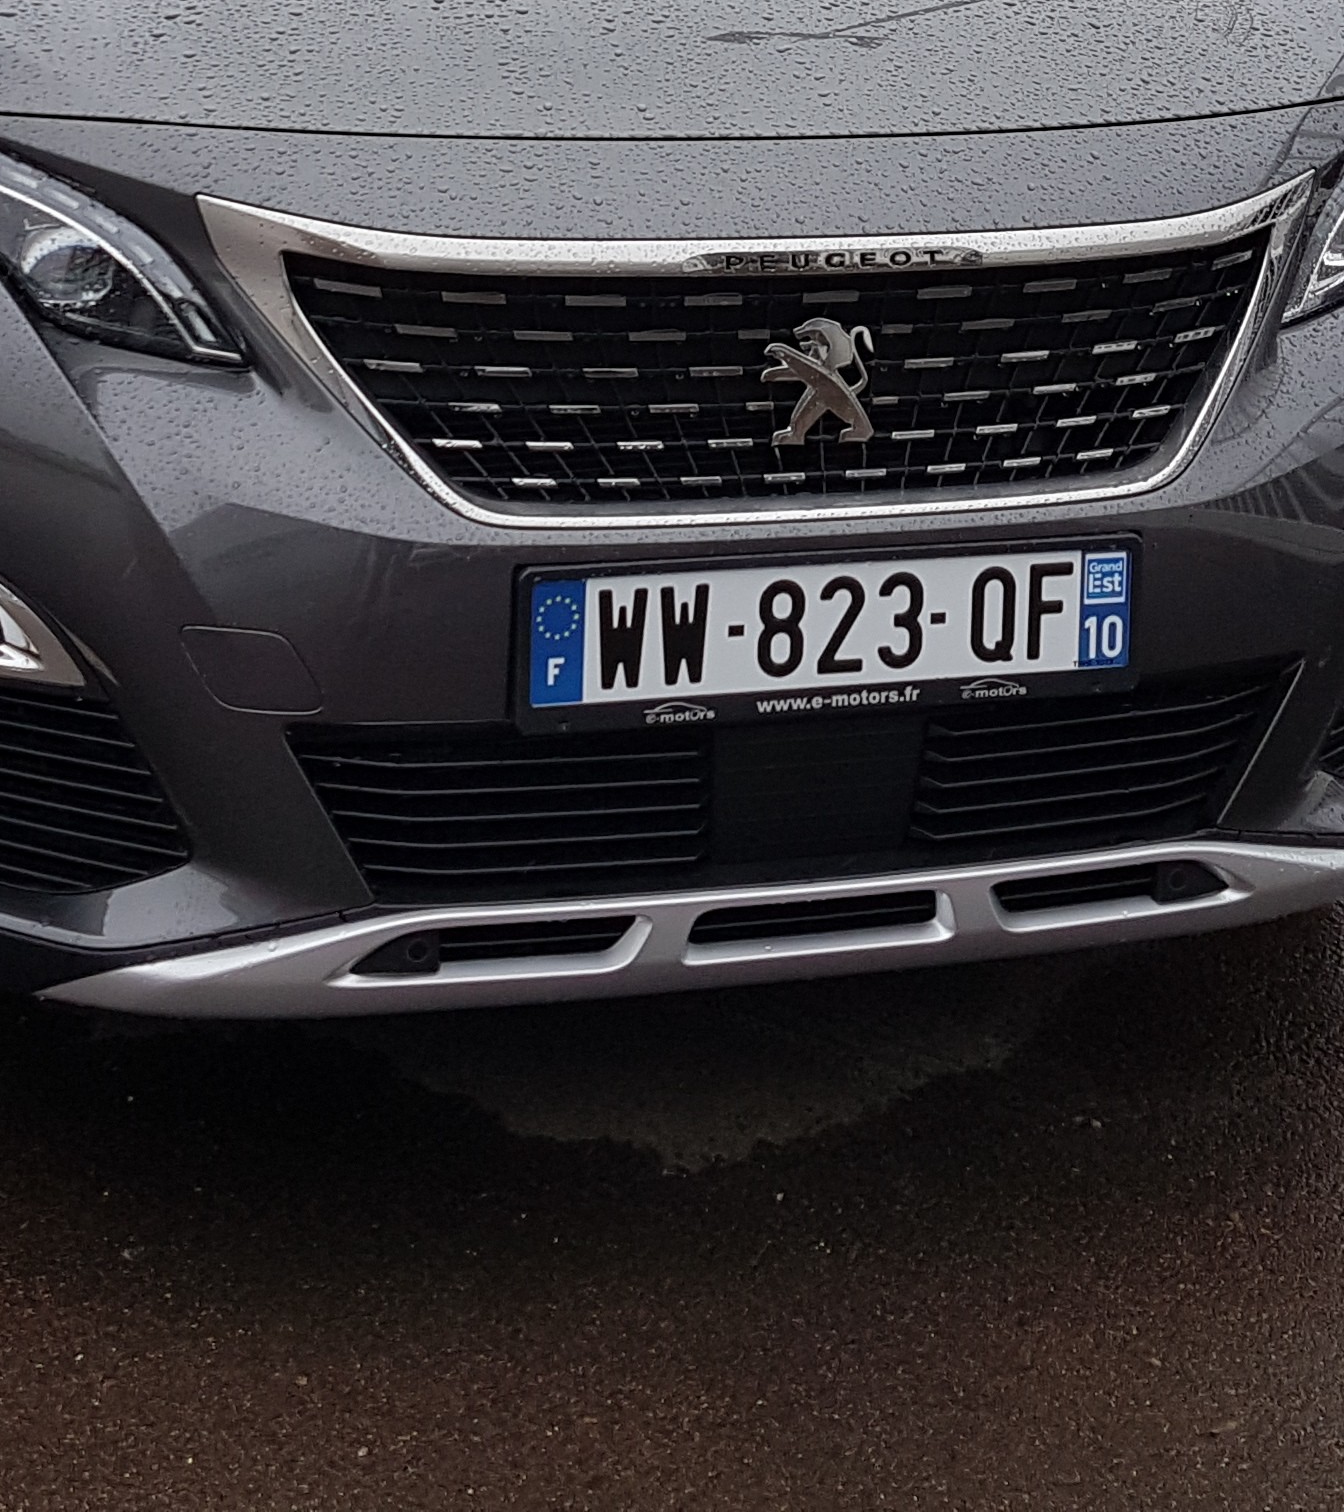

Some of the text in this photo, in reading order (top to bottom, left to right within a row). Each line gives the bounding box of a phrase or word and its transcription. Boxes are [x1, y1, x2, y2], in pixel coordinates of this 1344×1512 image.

[724, 249, 944, 271] PEUGEOT
[1089, 560, 1123, 573] Grand
[1089, 573, 1122, 593] Est
[1084, 615, 1123, 659] 10
[547, 657, 565, 686] F
[757, 685, 920, 714] www.e-motors.fr
